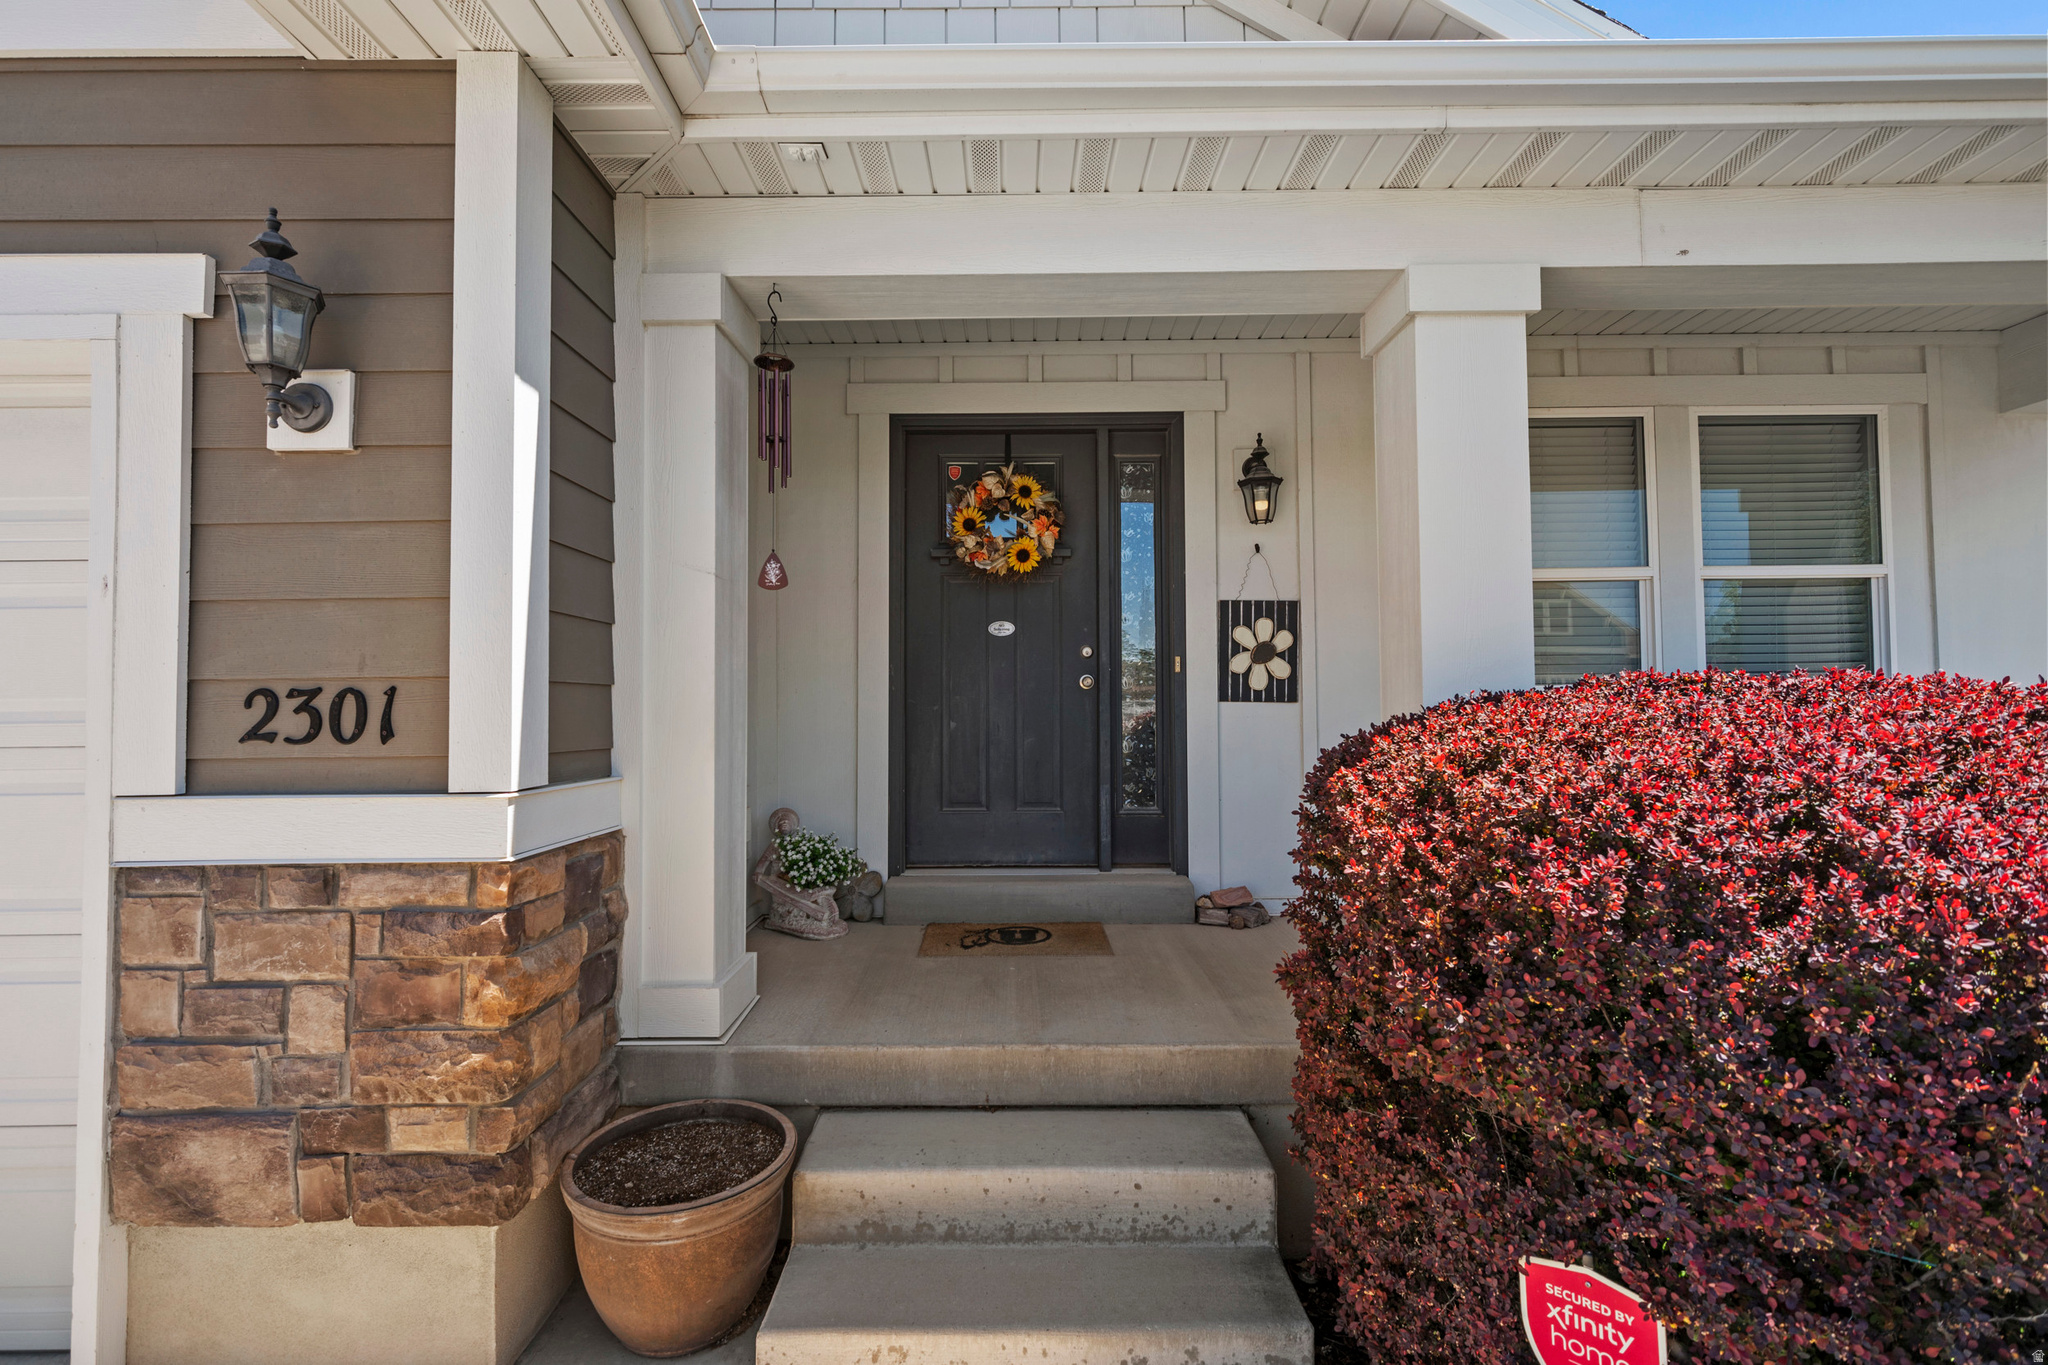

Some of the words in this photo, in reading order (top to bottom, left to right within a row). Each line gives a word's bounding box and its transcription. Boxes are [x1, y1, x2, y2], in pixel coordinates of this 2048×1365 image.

[238, 685, 397, 745] 2301
[1545, 1283, 1611, 1317] SECURED
[1615, 1310, 1635, 1327] BY
[1546, 1302, 1635, 1354] xfinity
